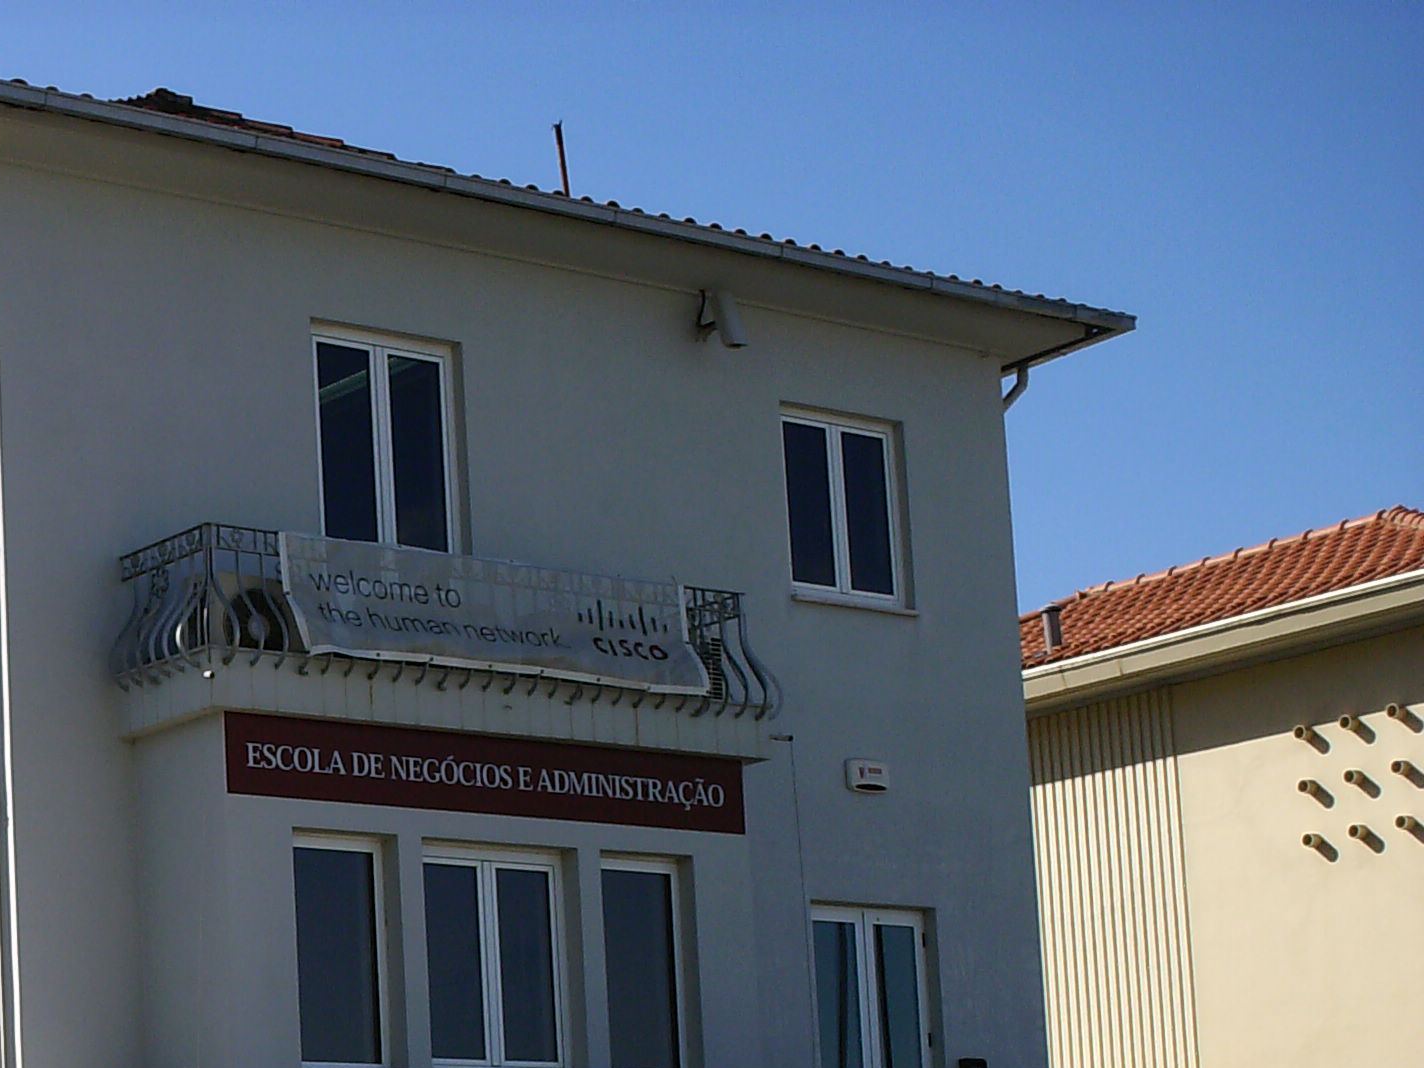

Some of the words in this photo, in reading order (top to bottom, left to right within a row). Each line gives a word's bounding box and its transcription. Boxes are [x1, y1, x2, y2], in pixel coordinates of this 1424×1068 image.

[309, 569, 429, 606] welcome
[436, 583, 461, 609] to
[318, 601, 362, 628] the
[370, 609, 460, 637] human
[245, 741, 346, 776] ESCOLA
[352, 752, 384, 779] DE
[390, 755, 512, 790] NEGÓCIOS
[518, 766, 533, 790] E
[537, 768, 724, 811] ADMINISTRAÇÃO
